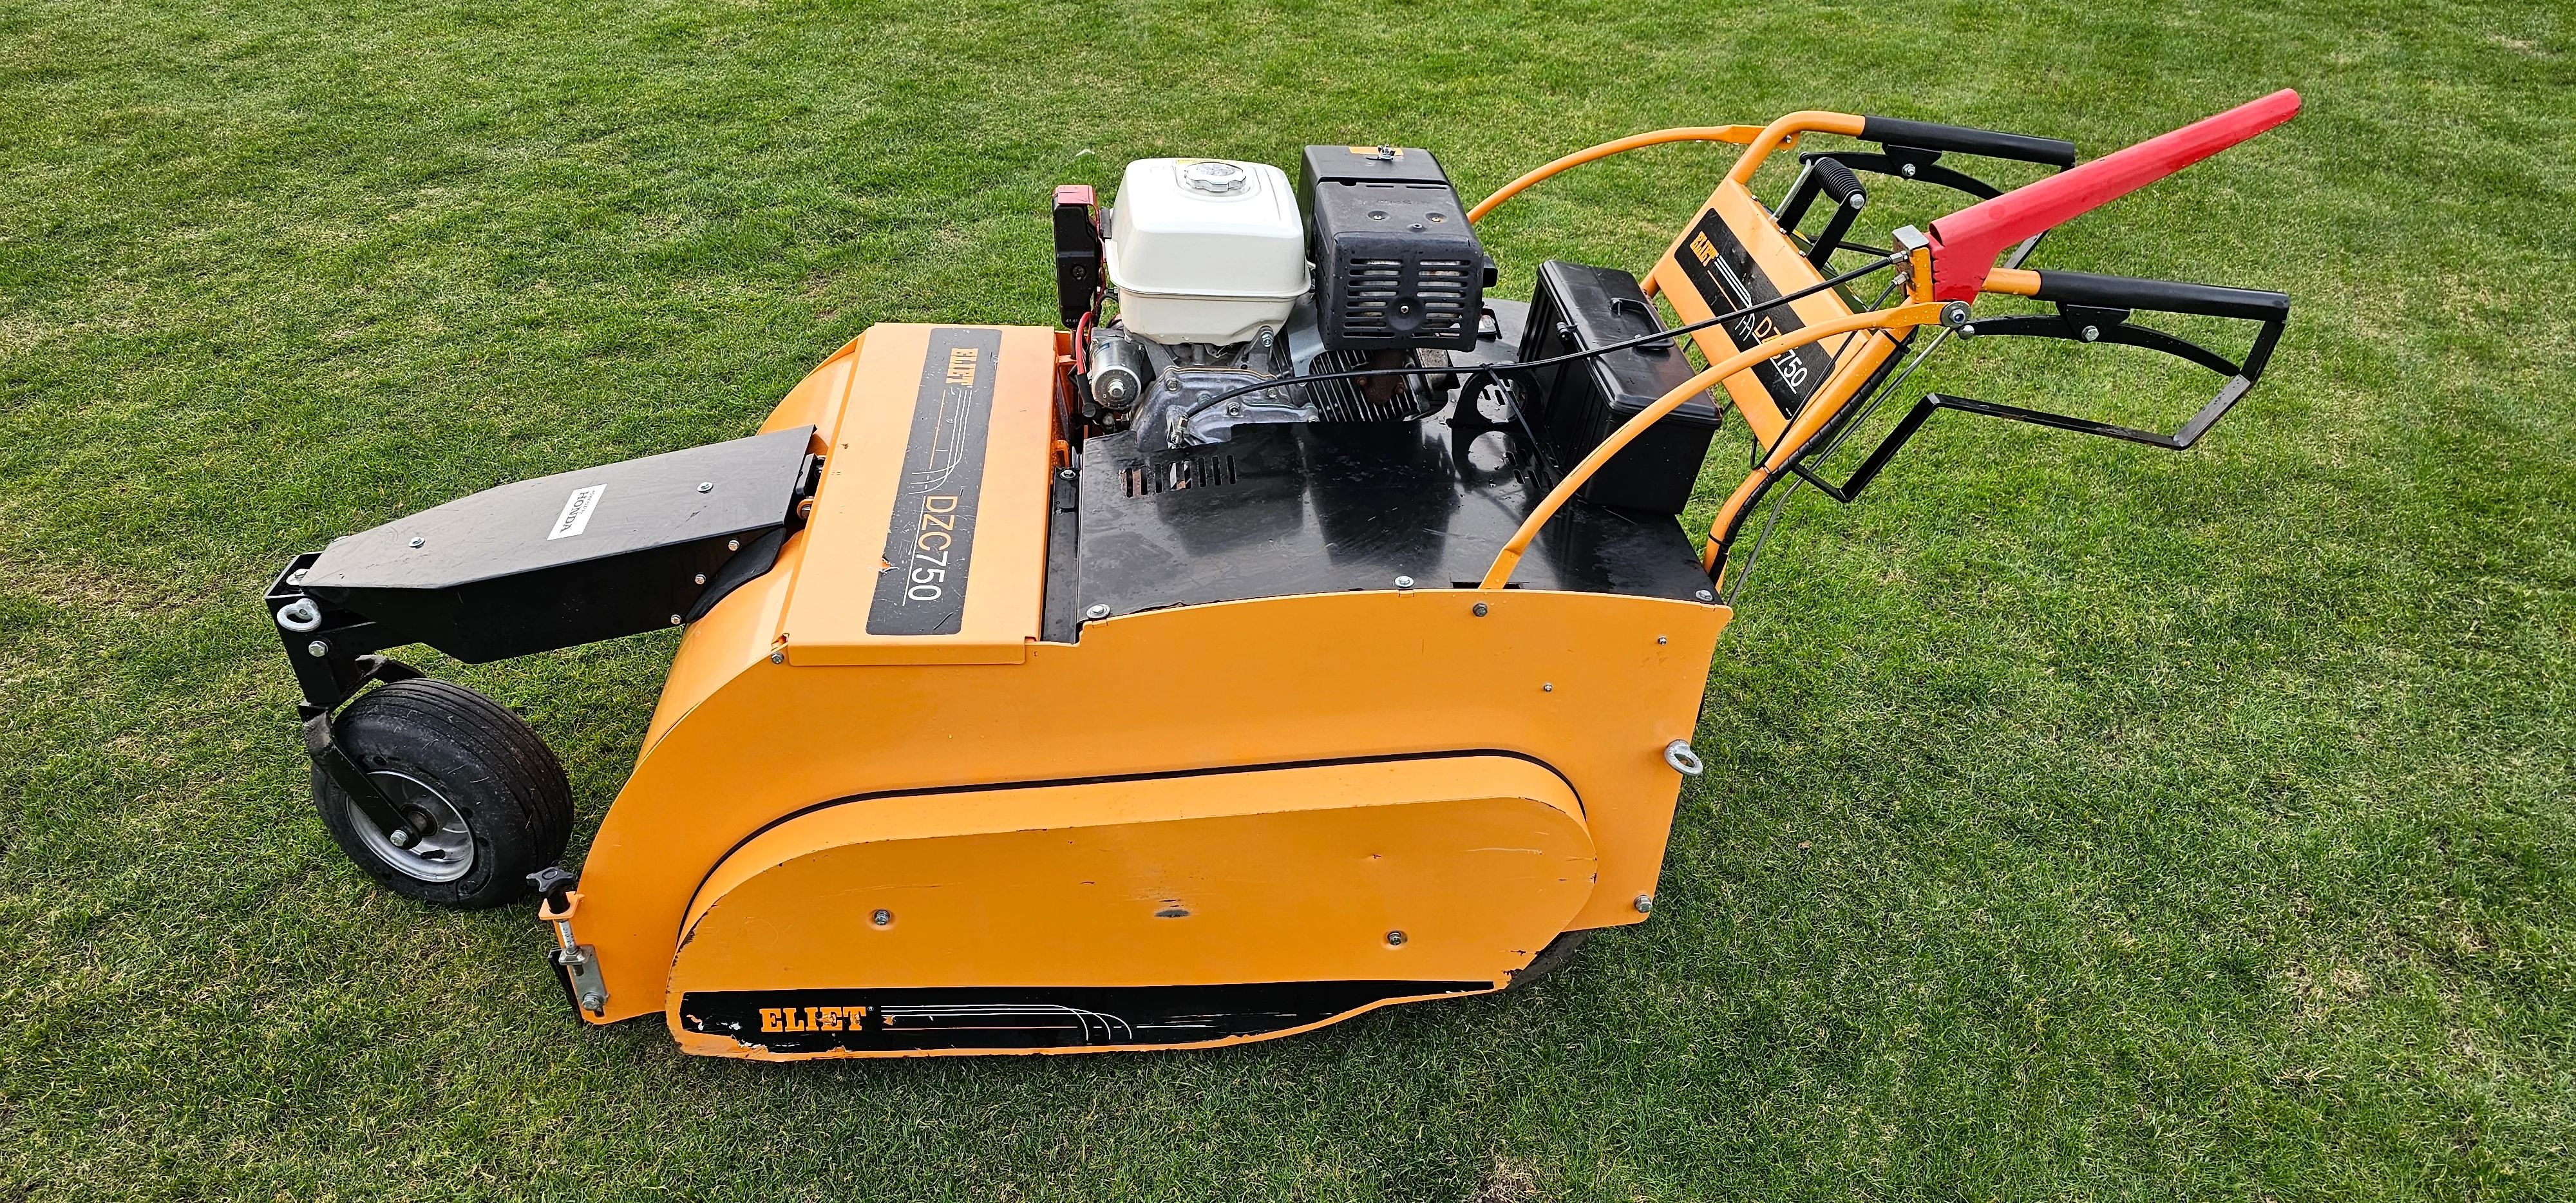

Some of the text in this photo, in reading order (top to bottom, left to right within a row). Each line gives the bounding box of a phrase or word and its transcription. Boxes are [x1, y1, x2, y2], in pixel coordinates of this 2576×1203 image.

[1689, 231, 1719, 267] ELIET
[945, 348, 979, 386] ELIET
[1754, 316, 1808, 388] DZ750
[560, 491, 589, 533] HONDA
[907, 496, 958, 601] DZC750
[759, 1006, 867, 1032] ELIET
